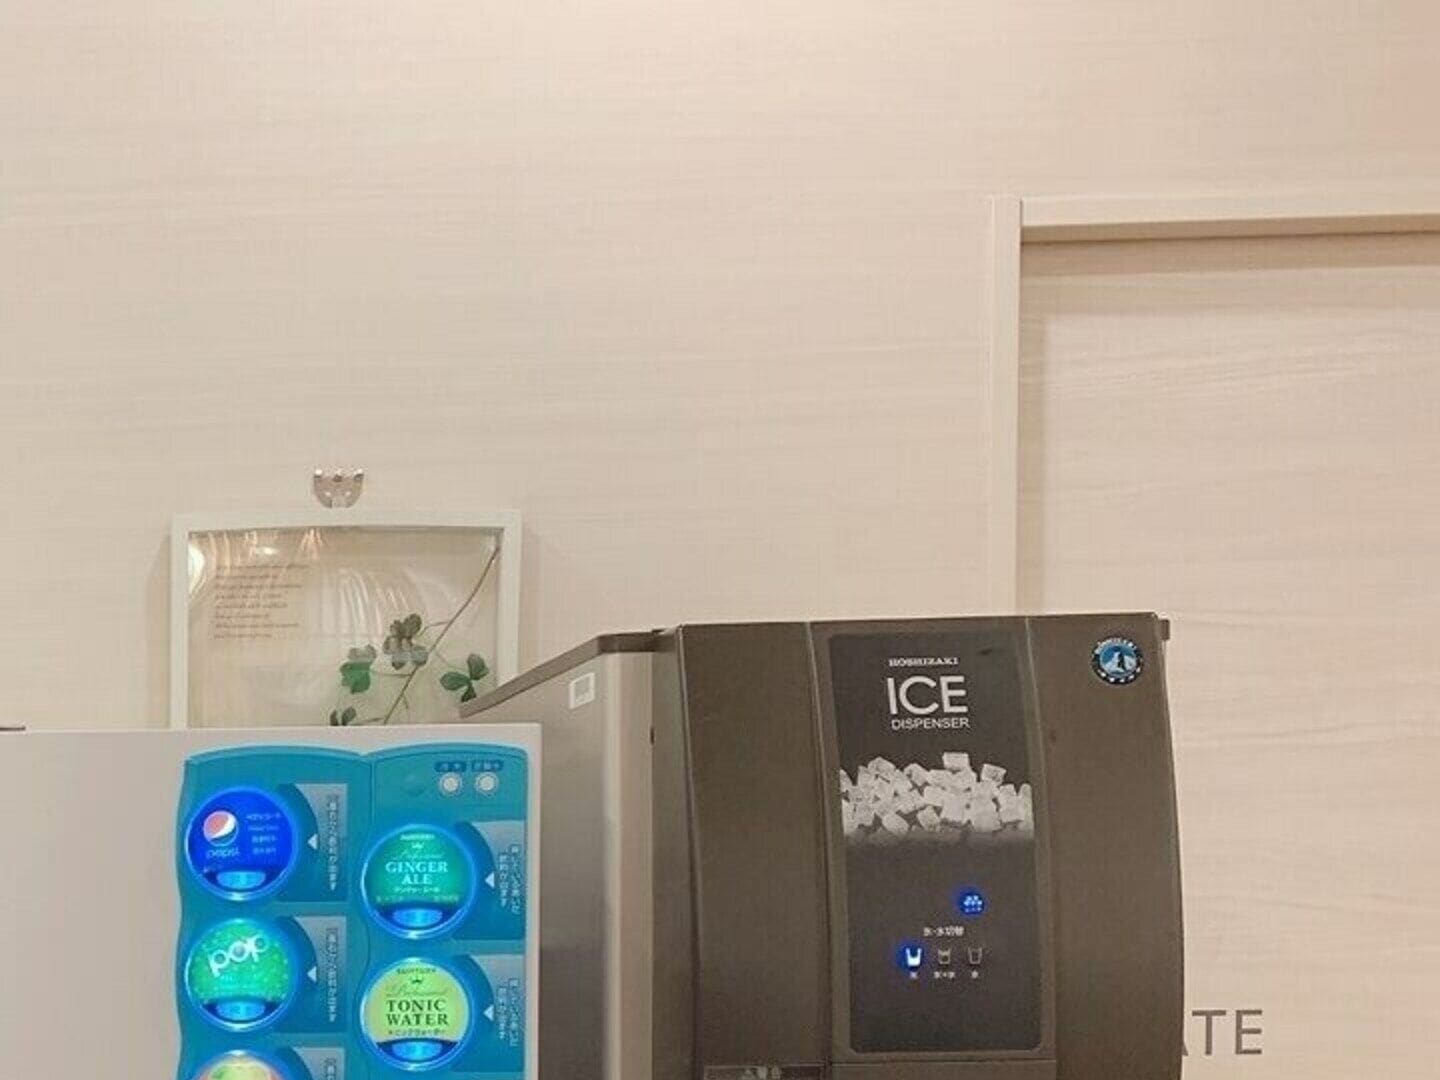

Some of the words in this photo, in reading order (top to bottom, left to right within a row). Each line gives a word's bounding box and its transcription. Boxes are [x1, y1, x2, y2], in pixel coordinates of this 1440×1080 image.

[888, 657, 959, 667] HOSHIZAKI
[887, 675, 968, 715] ICE
[891, 717, 971, 731] DISPENSER
[385, 861, 449, 873] GINGER
[401, 873, 434, 885] ALE
[209, 933, 270, 978] pop
[386, 999, 447, 1012] TONIC
[386, 1013, 449, 1026] WATER
[1182, 1010, 1262, 1056] TE
